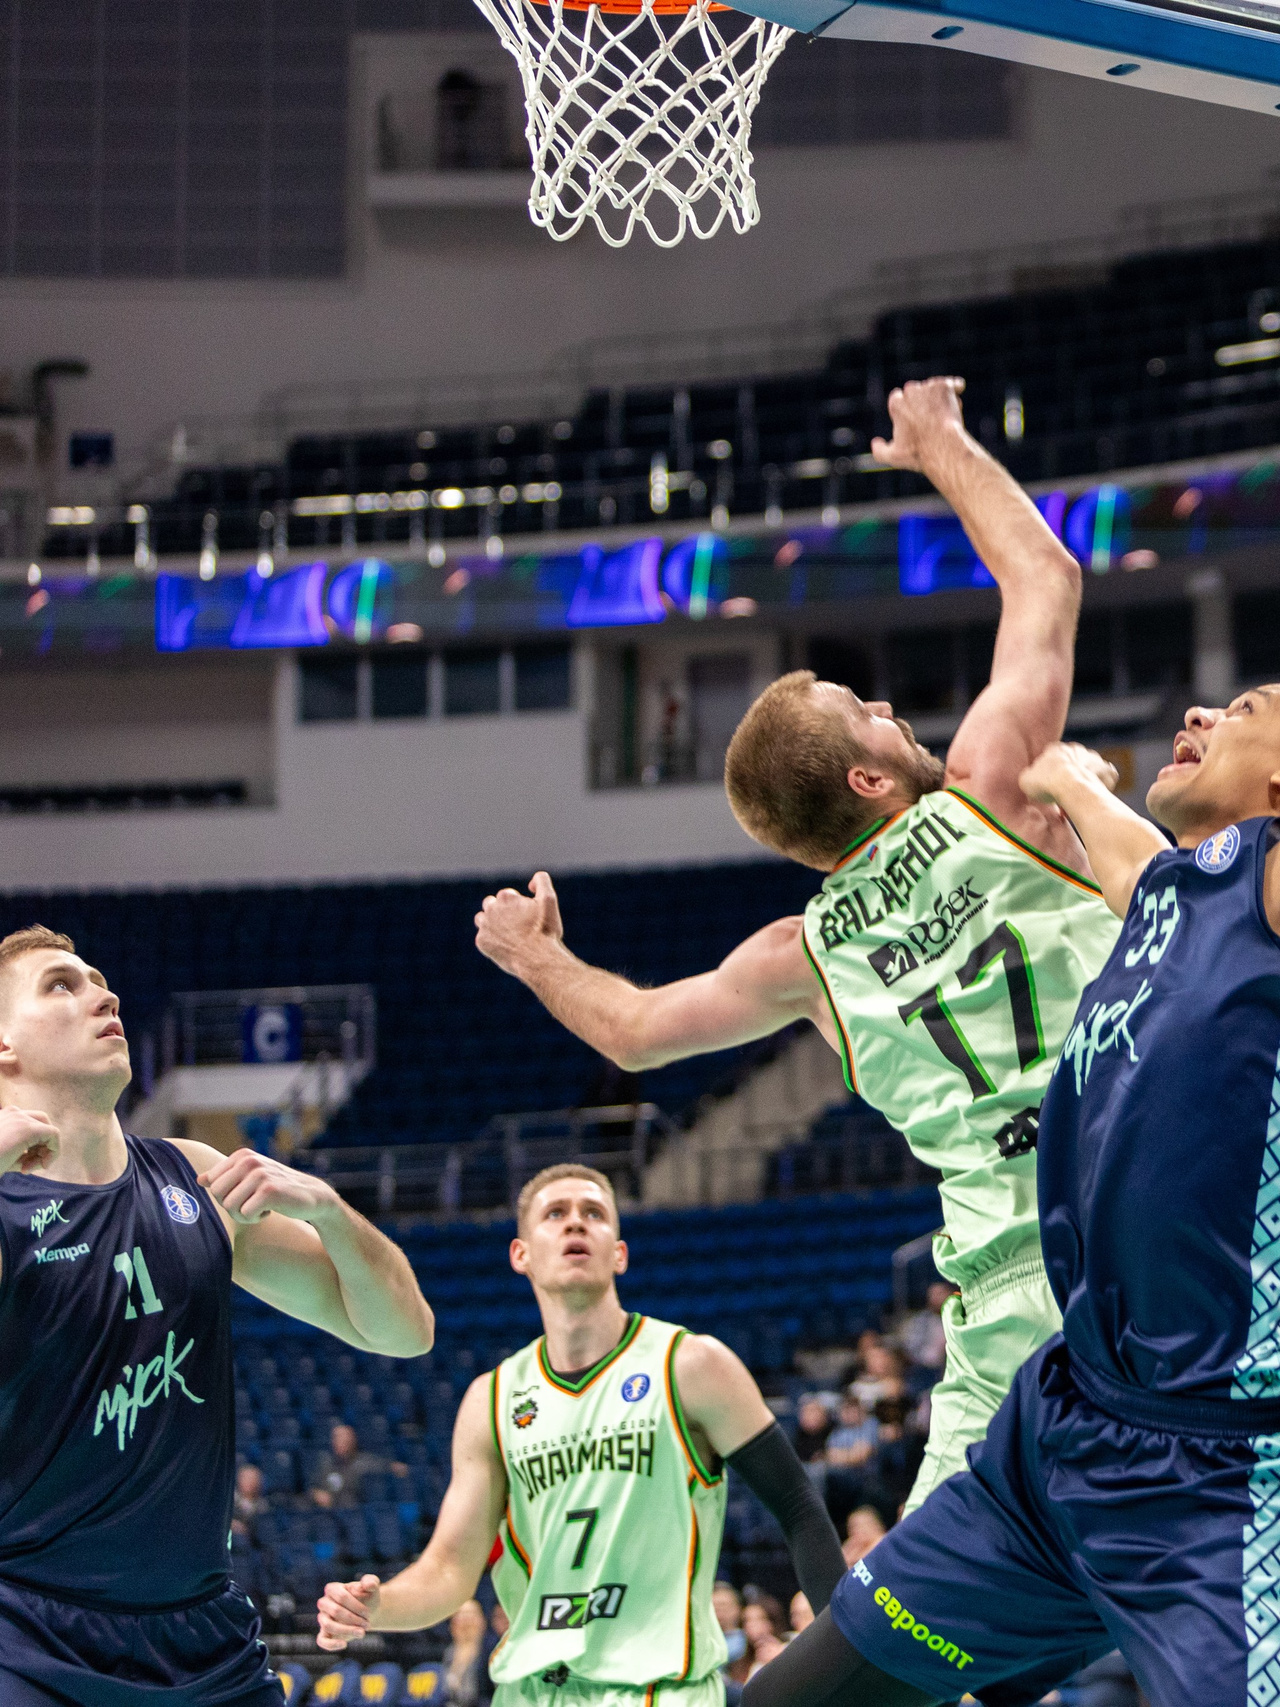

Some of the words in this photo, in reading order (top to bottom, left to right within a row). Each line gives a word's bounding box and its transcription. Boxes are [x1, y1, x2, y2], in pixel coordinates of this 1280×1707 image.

[1125, 885, 1180, 968] 33
[897, 920, 1047, 1103] 17
[34, 1242, 90, 1265] Kempa
[566, 1507, 600, 1570] 7
[874, 1586, 974, 1670] евроопт
